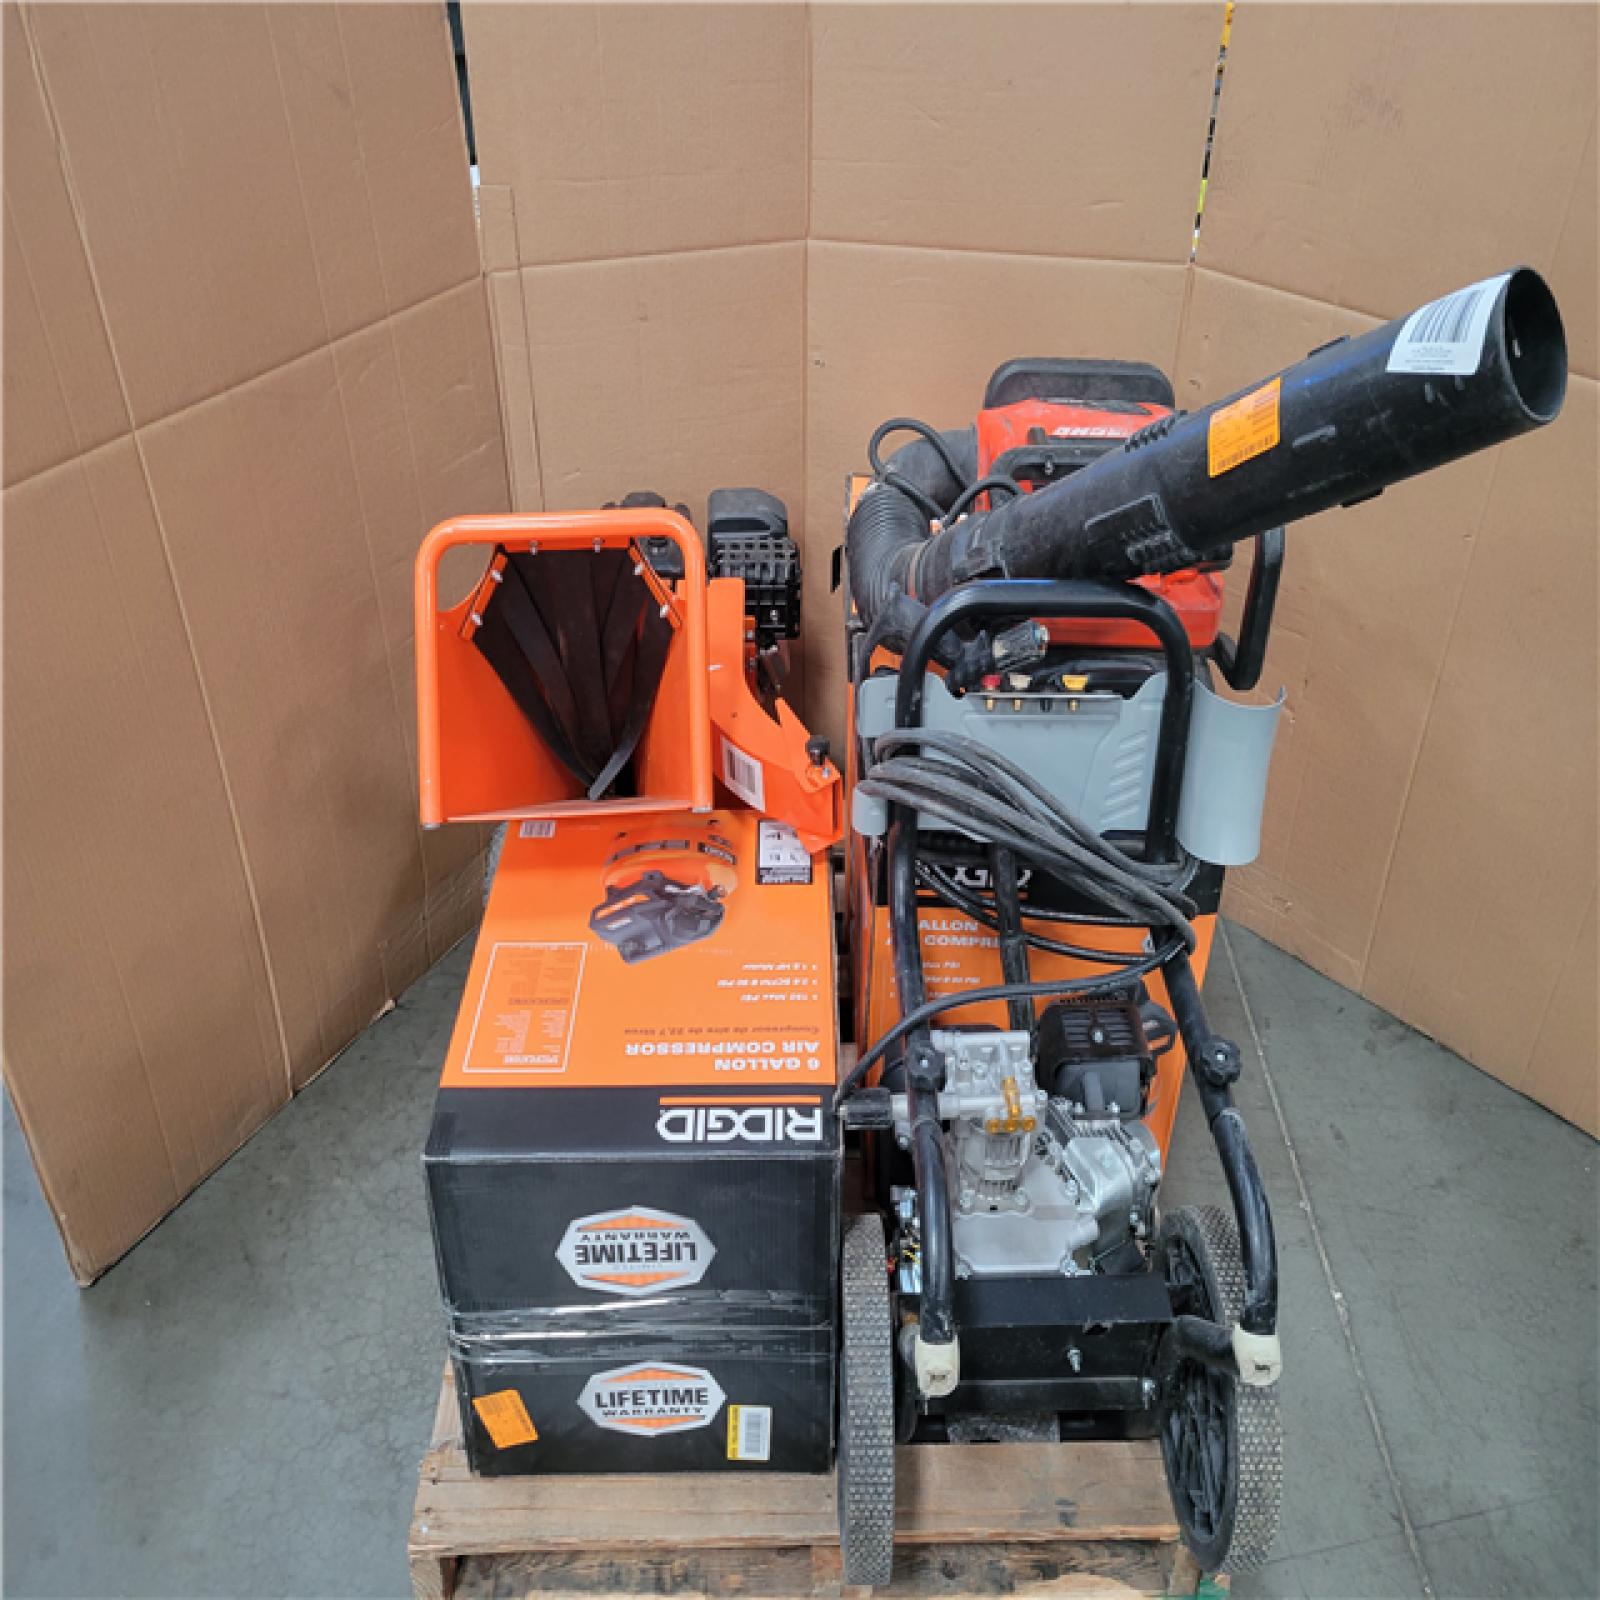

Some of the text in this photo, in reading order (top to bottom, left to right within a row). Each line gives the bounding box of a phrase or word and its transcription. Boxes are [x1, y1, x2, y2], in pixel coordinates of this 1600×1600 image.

[624, 1040, 820, 1056] AIR COMPRESSOR
[714, 1057, 821, 1072] 6 GALLON
[655, 1107, 823, 1142] RIDGID
[581, 1231, 690, 1242] WARRANTY
[574, 1242, 697, 1265] LIFETIME
[594, 1387, 709, 1409] LIFETIME
[602, 1406, 704, 1417] WARRANTY
